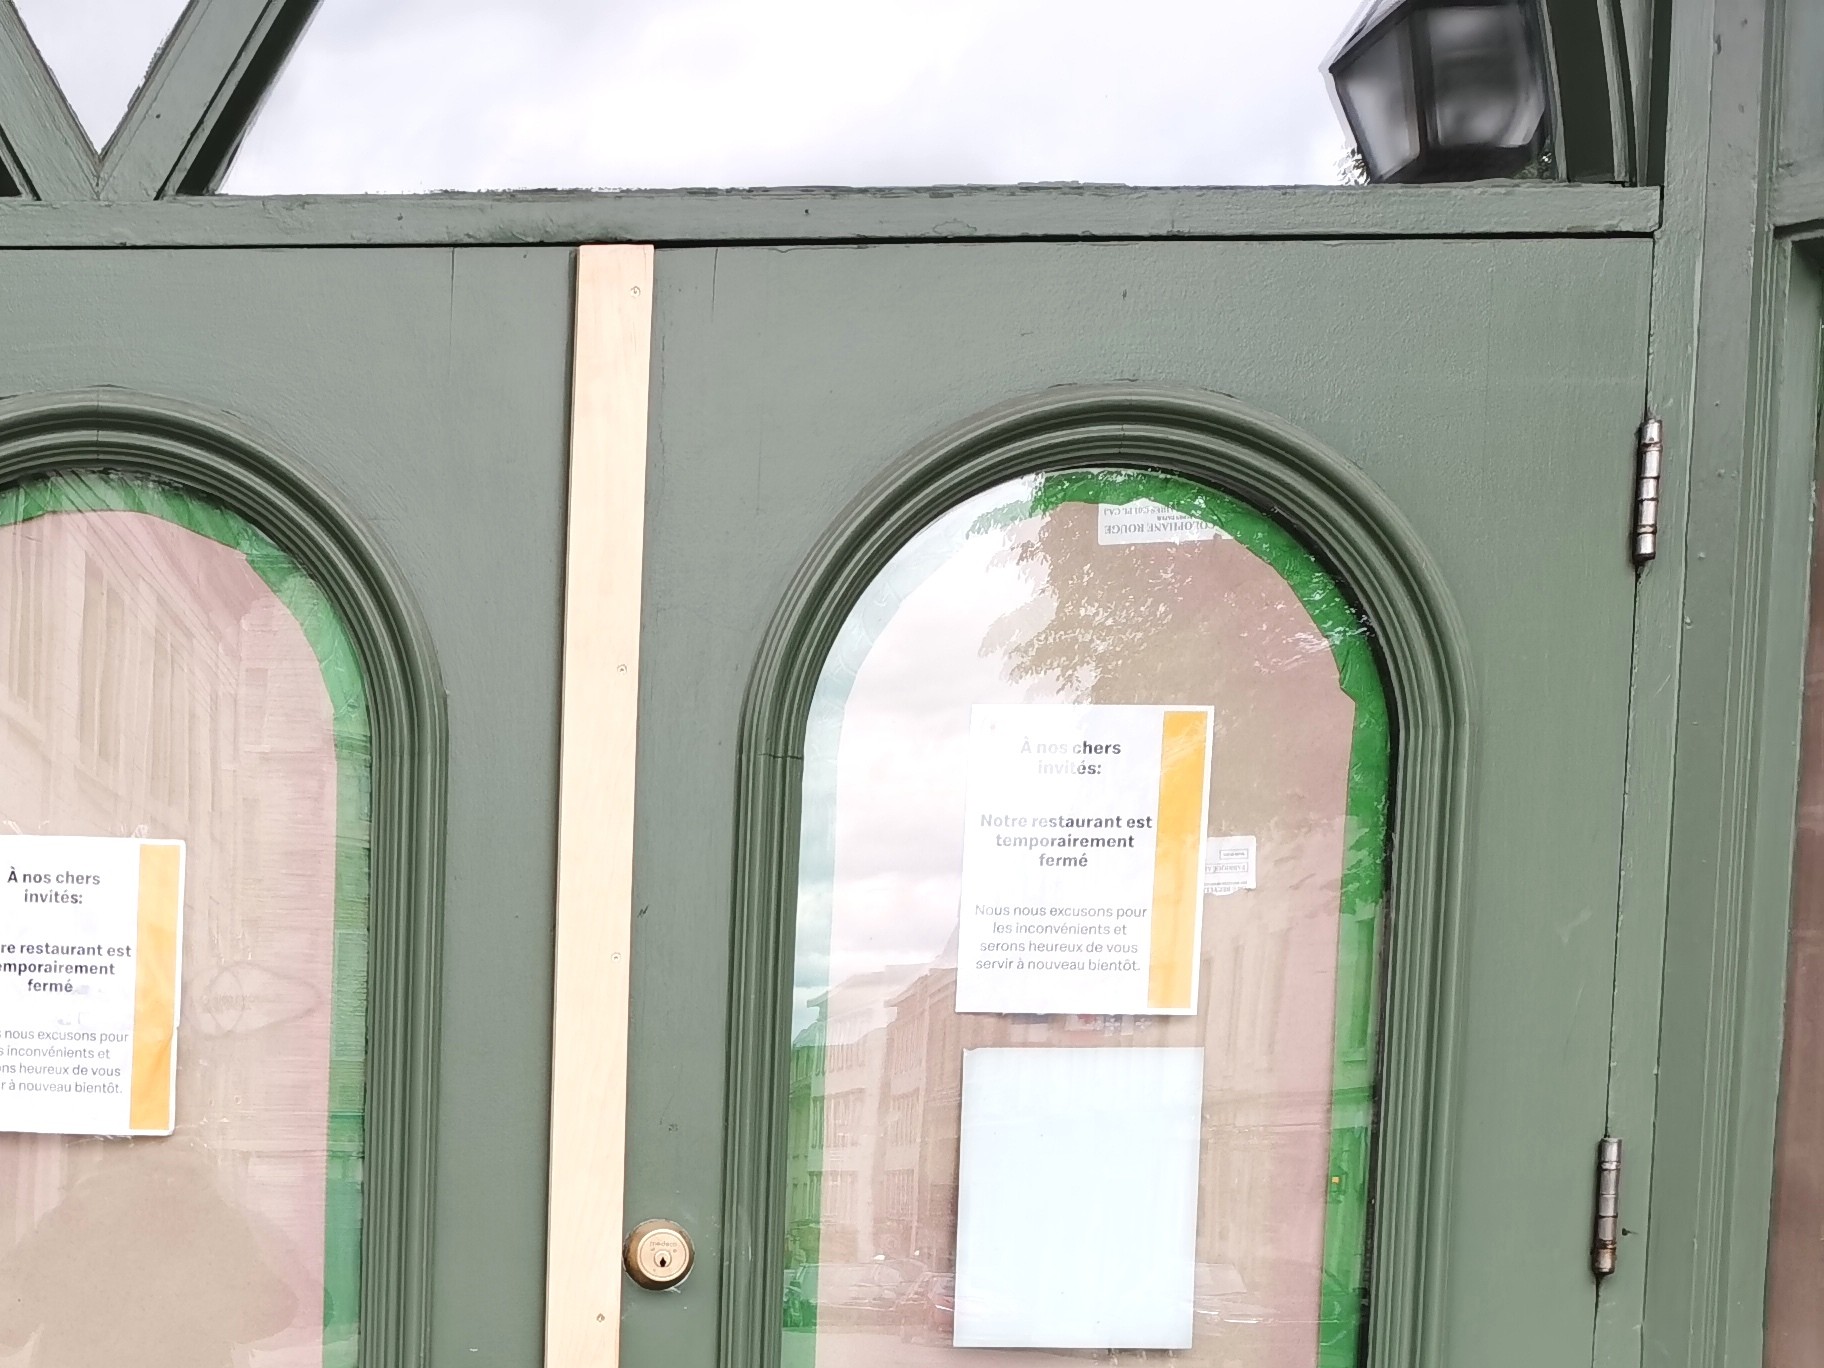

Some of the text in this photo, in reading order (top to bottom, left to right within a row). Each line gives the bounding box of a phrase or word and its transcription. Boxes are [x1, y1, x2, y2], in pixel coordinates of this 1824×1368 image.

[1104, 523, 1145, 535] ROUGE
[1072, 740, 1122, 755] chers
[980, 814, 1153, 829] Notre restaurant est
[995, 832, 1136, 850] temporairement
[1038, 853, 1088, 867] fermé
[7, 865, 101, 885] À nos chers
[24, 889, 84, 905] invités:
[975, 905, 1148, 920] Nous nous excusons pour
[993, 922, 1128, 936] les inconvénients et
[20, 944, 103, 956] restaurant
[107, 945, 132, 957] est
[980, 940, 1139, 954] serons heureux de vous
[975, 957, 1141, 971] servir à nouveau bientôt.
[27, 979, 74, 993] fermé
[5, 1030, 34, 1040] nous
[37, 1031, 97, 1042] excusons
[99, 1032, 129, 1045] pour
[7, 1045, 94, 1059] inconvénients
[97, 1049, 111, 1059] et
[19, 1063, 70, 1076] heureux
[72, 1064, 89, 1076] de
[91, 1066, 121, 1077] vous
[9, 1079, 16, 1091] à
[19, 1081, 72, 1093] nouveau
[74, 1081, 123, 1095] bientôt.
